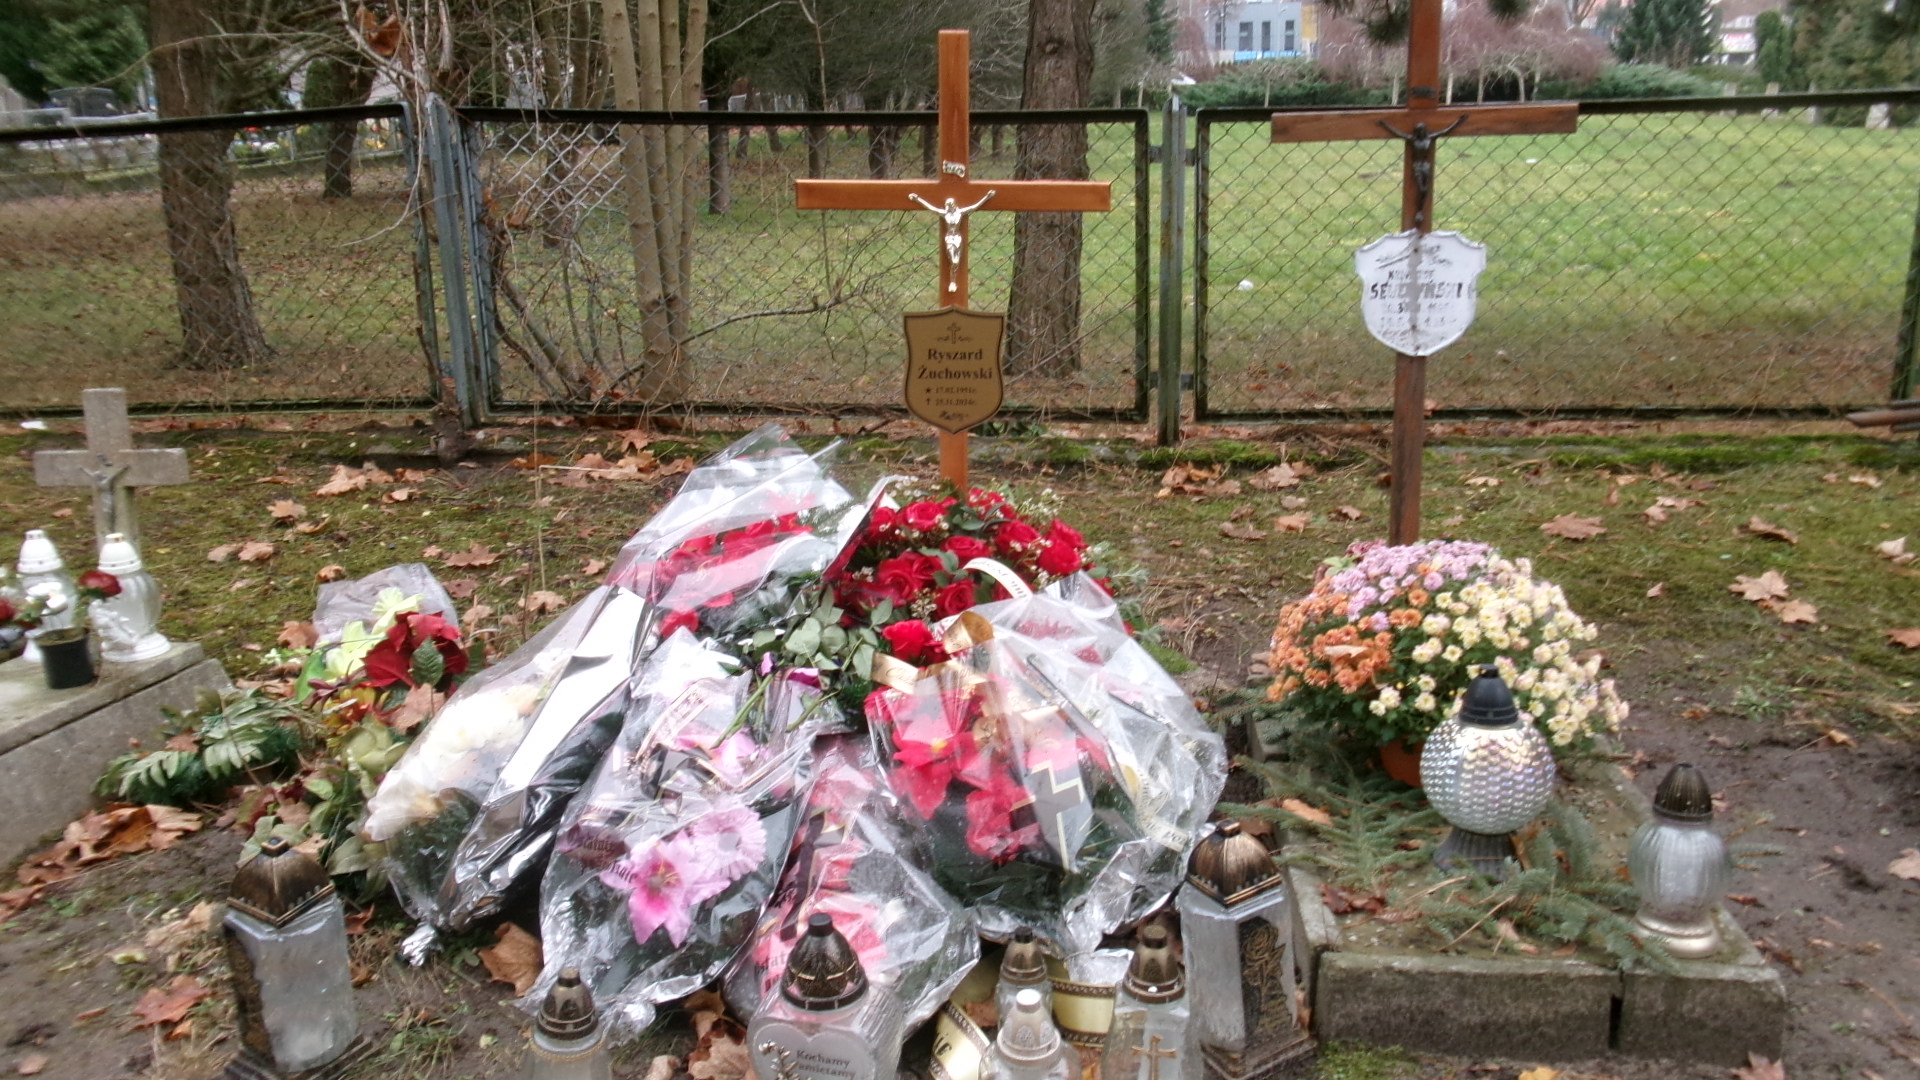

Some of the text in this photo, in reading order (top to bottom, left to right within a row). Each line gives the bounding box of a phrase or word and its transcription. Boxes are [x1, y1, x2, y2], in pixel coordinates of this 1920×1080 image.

[928, 348, 983, 363] Ryszard
[918, 365, 993, 379] Żuchowski
[796, 1049, 850, 1069] Kochamy
